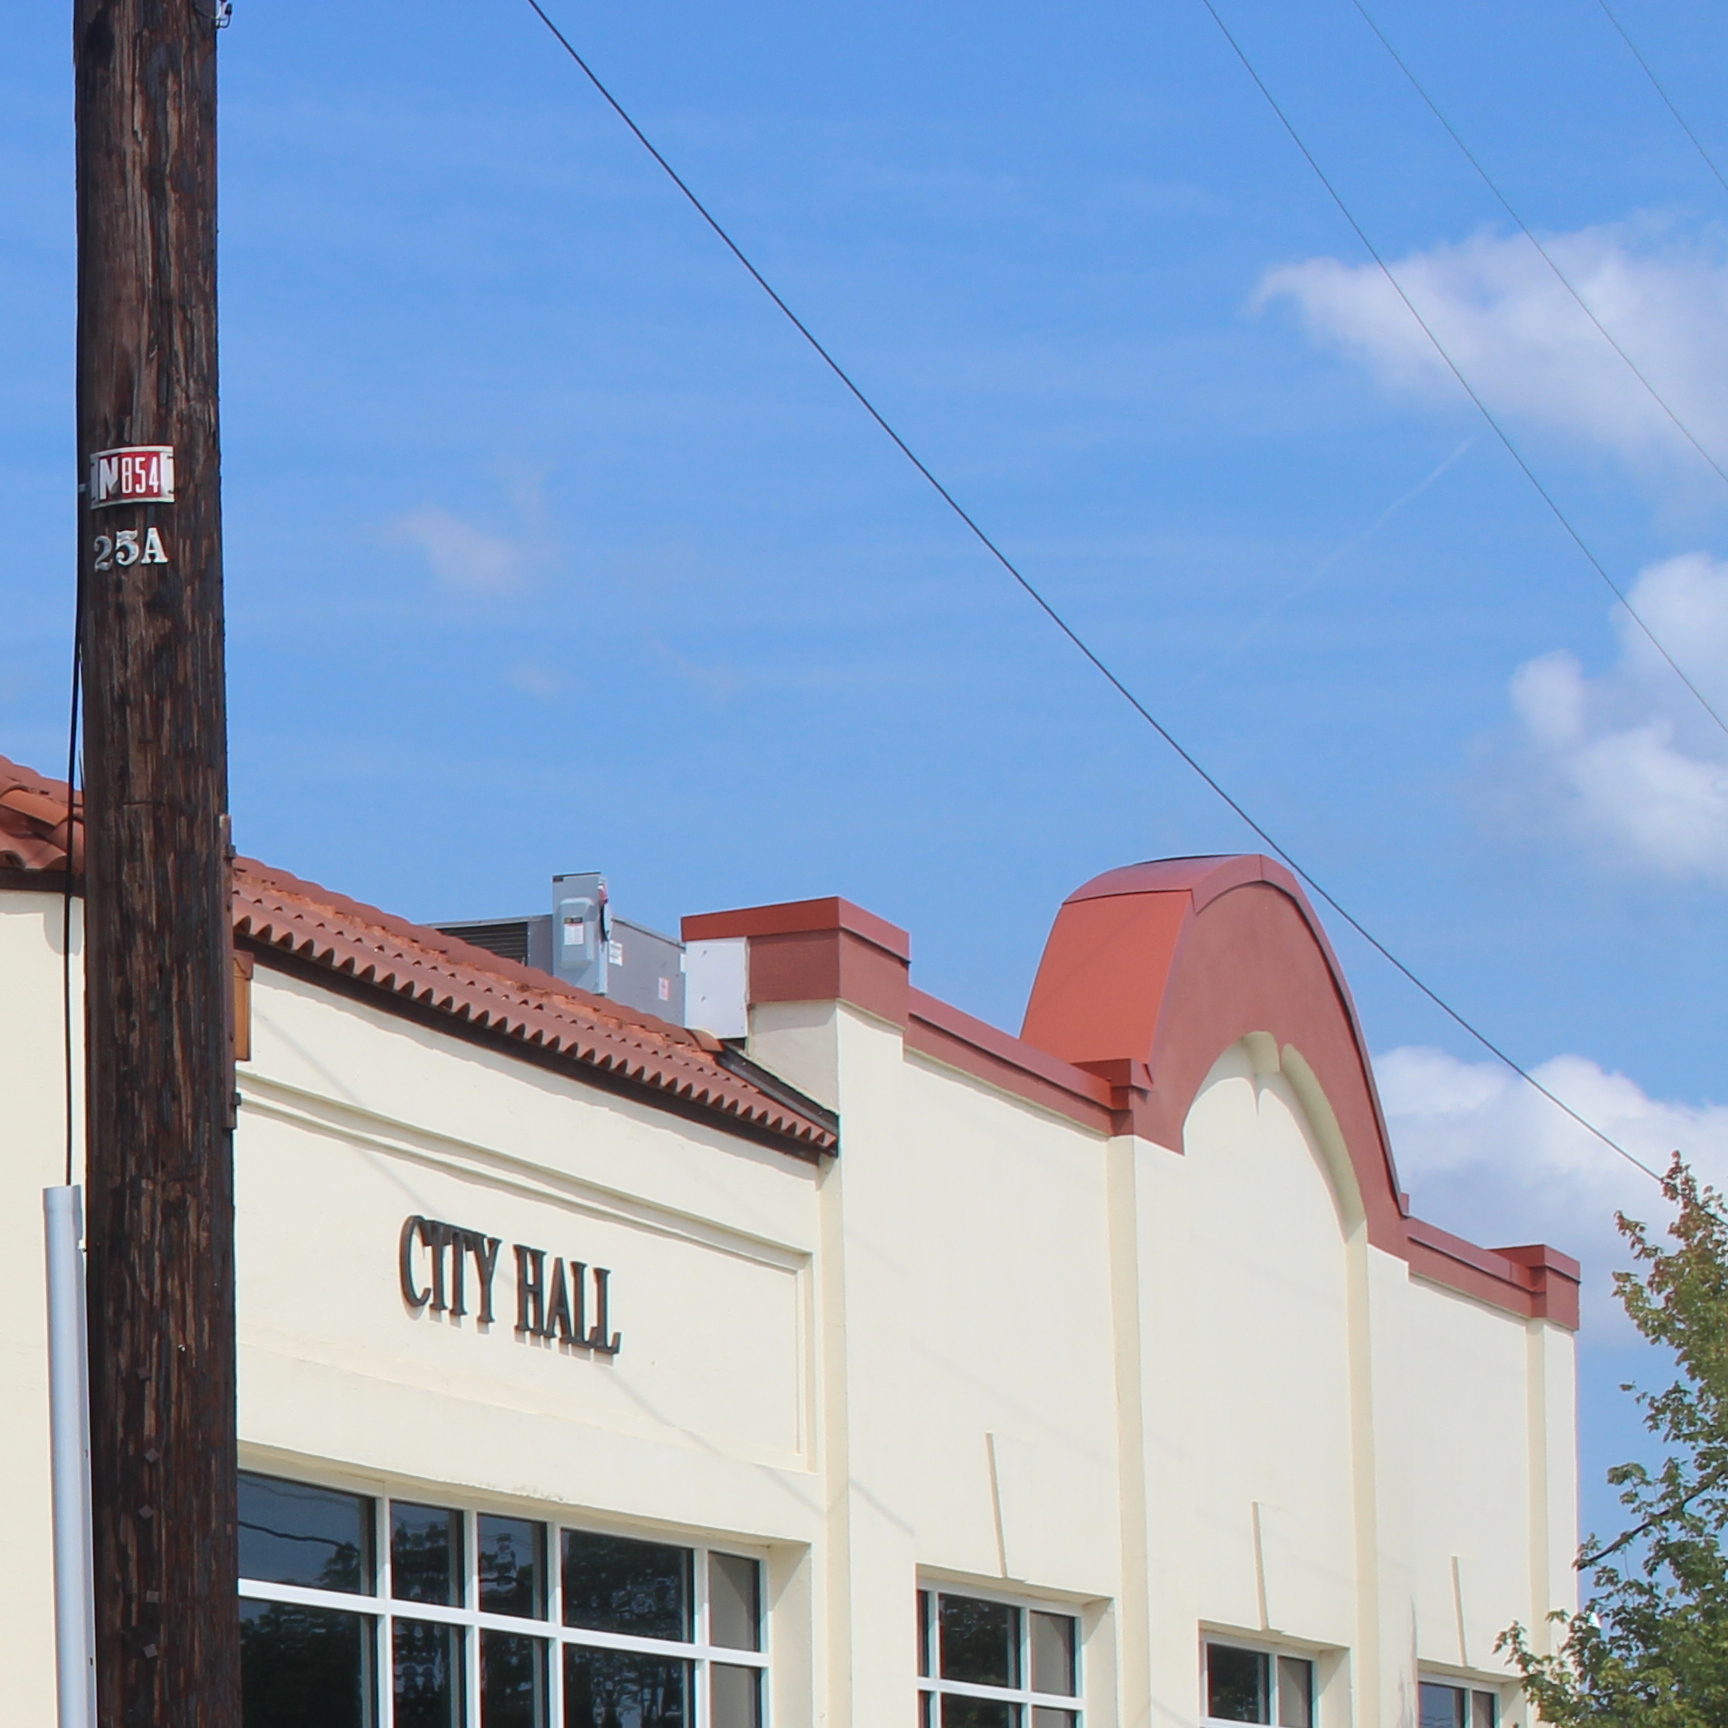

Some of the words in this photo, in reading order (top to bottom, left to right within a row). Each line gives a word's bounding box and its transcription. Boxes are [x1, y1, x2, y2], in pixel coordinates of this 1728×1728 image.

[94, 527, 169, 572] 25A
[399, 1214, 503, 1324] CITY
[513, 1244, 622, 1356] HALL
